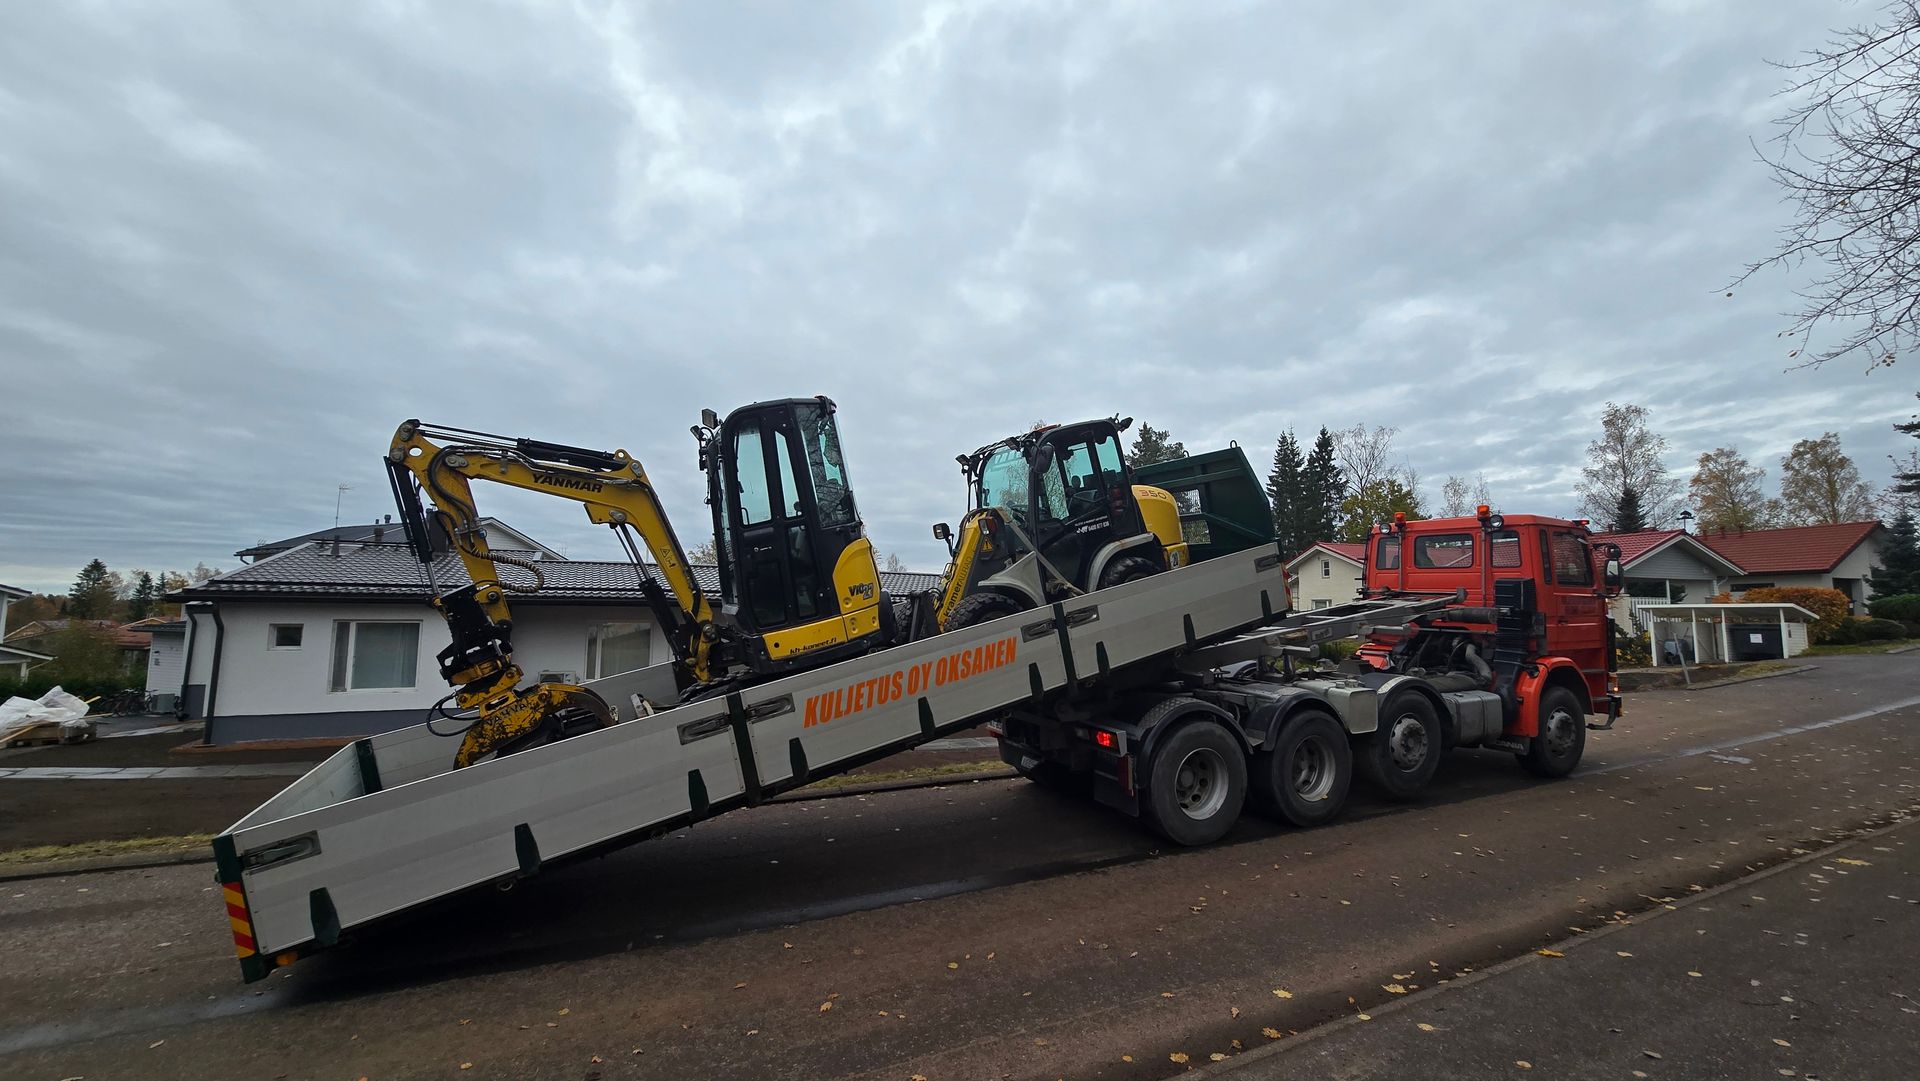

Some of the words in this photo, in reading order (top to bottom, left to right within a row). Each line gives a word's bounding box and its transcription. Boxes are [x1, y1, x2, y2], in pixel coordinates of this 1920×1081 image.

[532, 473, 603, 493] YANMAR
[1139, 489, 1167, 500] 350
[790, 637, 837, 655] kh-koneet.fi
[803, 671, 904, 729] KULJETUS
[907, 661, 934, 697] OY
[935, 636, 1018, 687] OKSANEN
